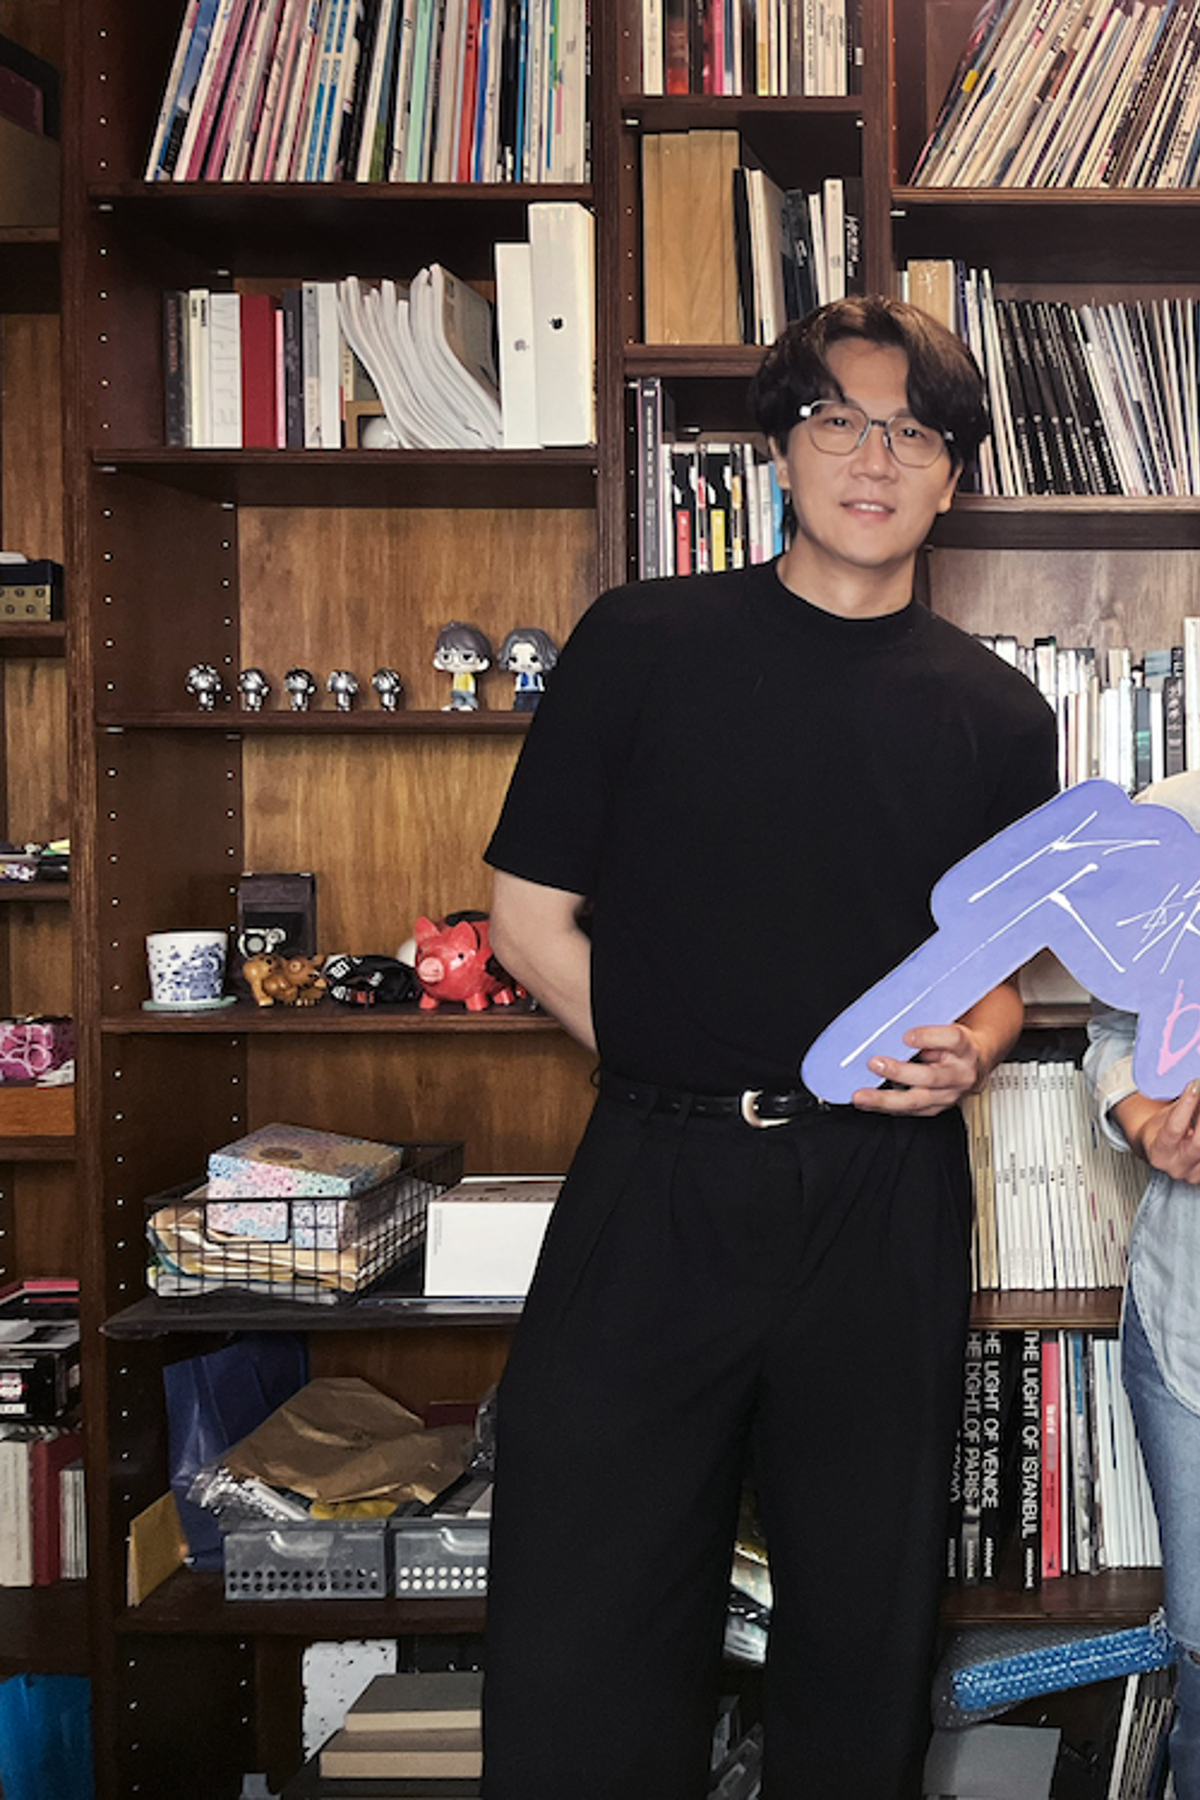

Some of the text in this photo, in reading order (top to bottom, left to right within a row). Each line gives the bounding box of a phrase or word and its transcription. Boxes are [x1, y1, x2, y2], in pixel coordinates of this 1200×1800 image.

[964, 1361, 982, 1414] LIGHT
[983, 1360, 1001, 1412] LIGHT
[964, 1413, 981, 1443] OF
[983, 1417, 1000, 1442] OF
[1021, 1330, 1041, 1539] THE LIGHT OF ISTANBUL
[963, 1447, 980, 1498] PARIS
[982, 1446, 999, 1509] VENICE
